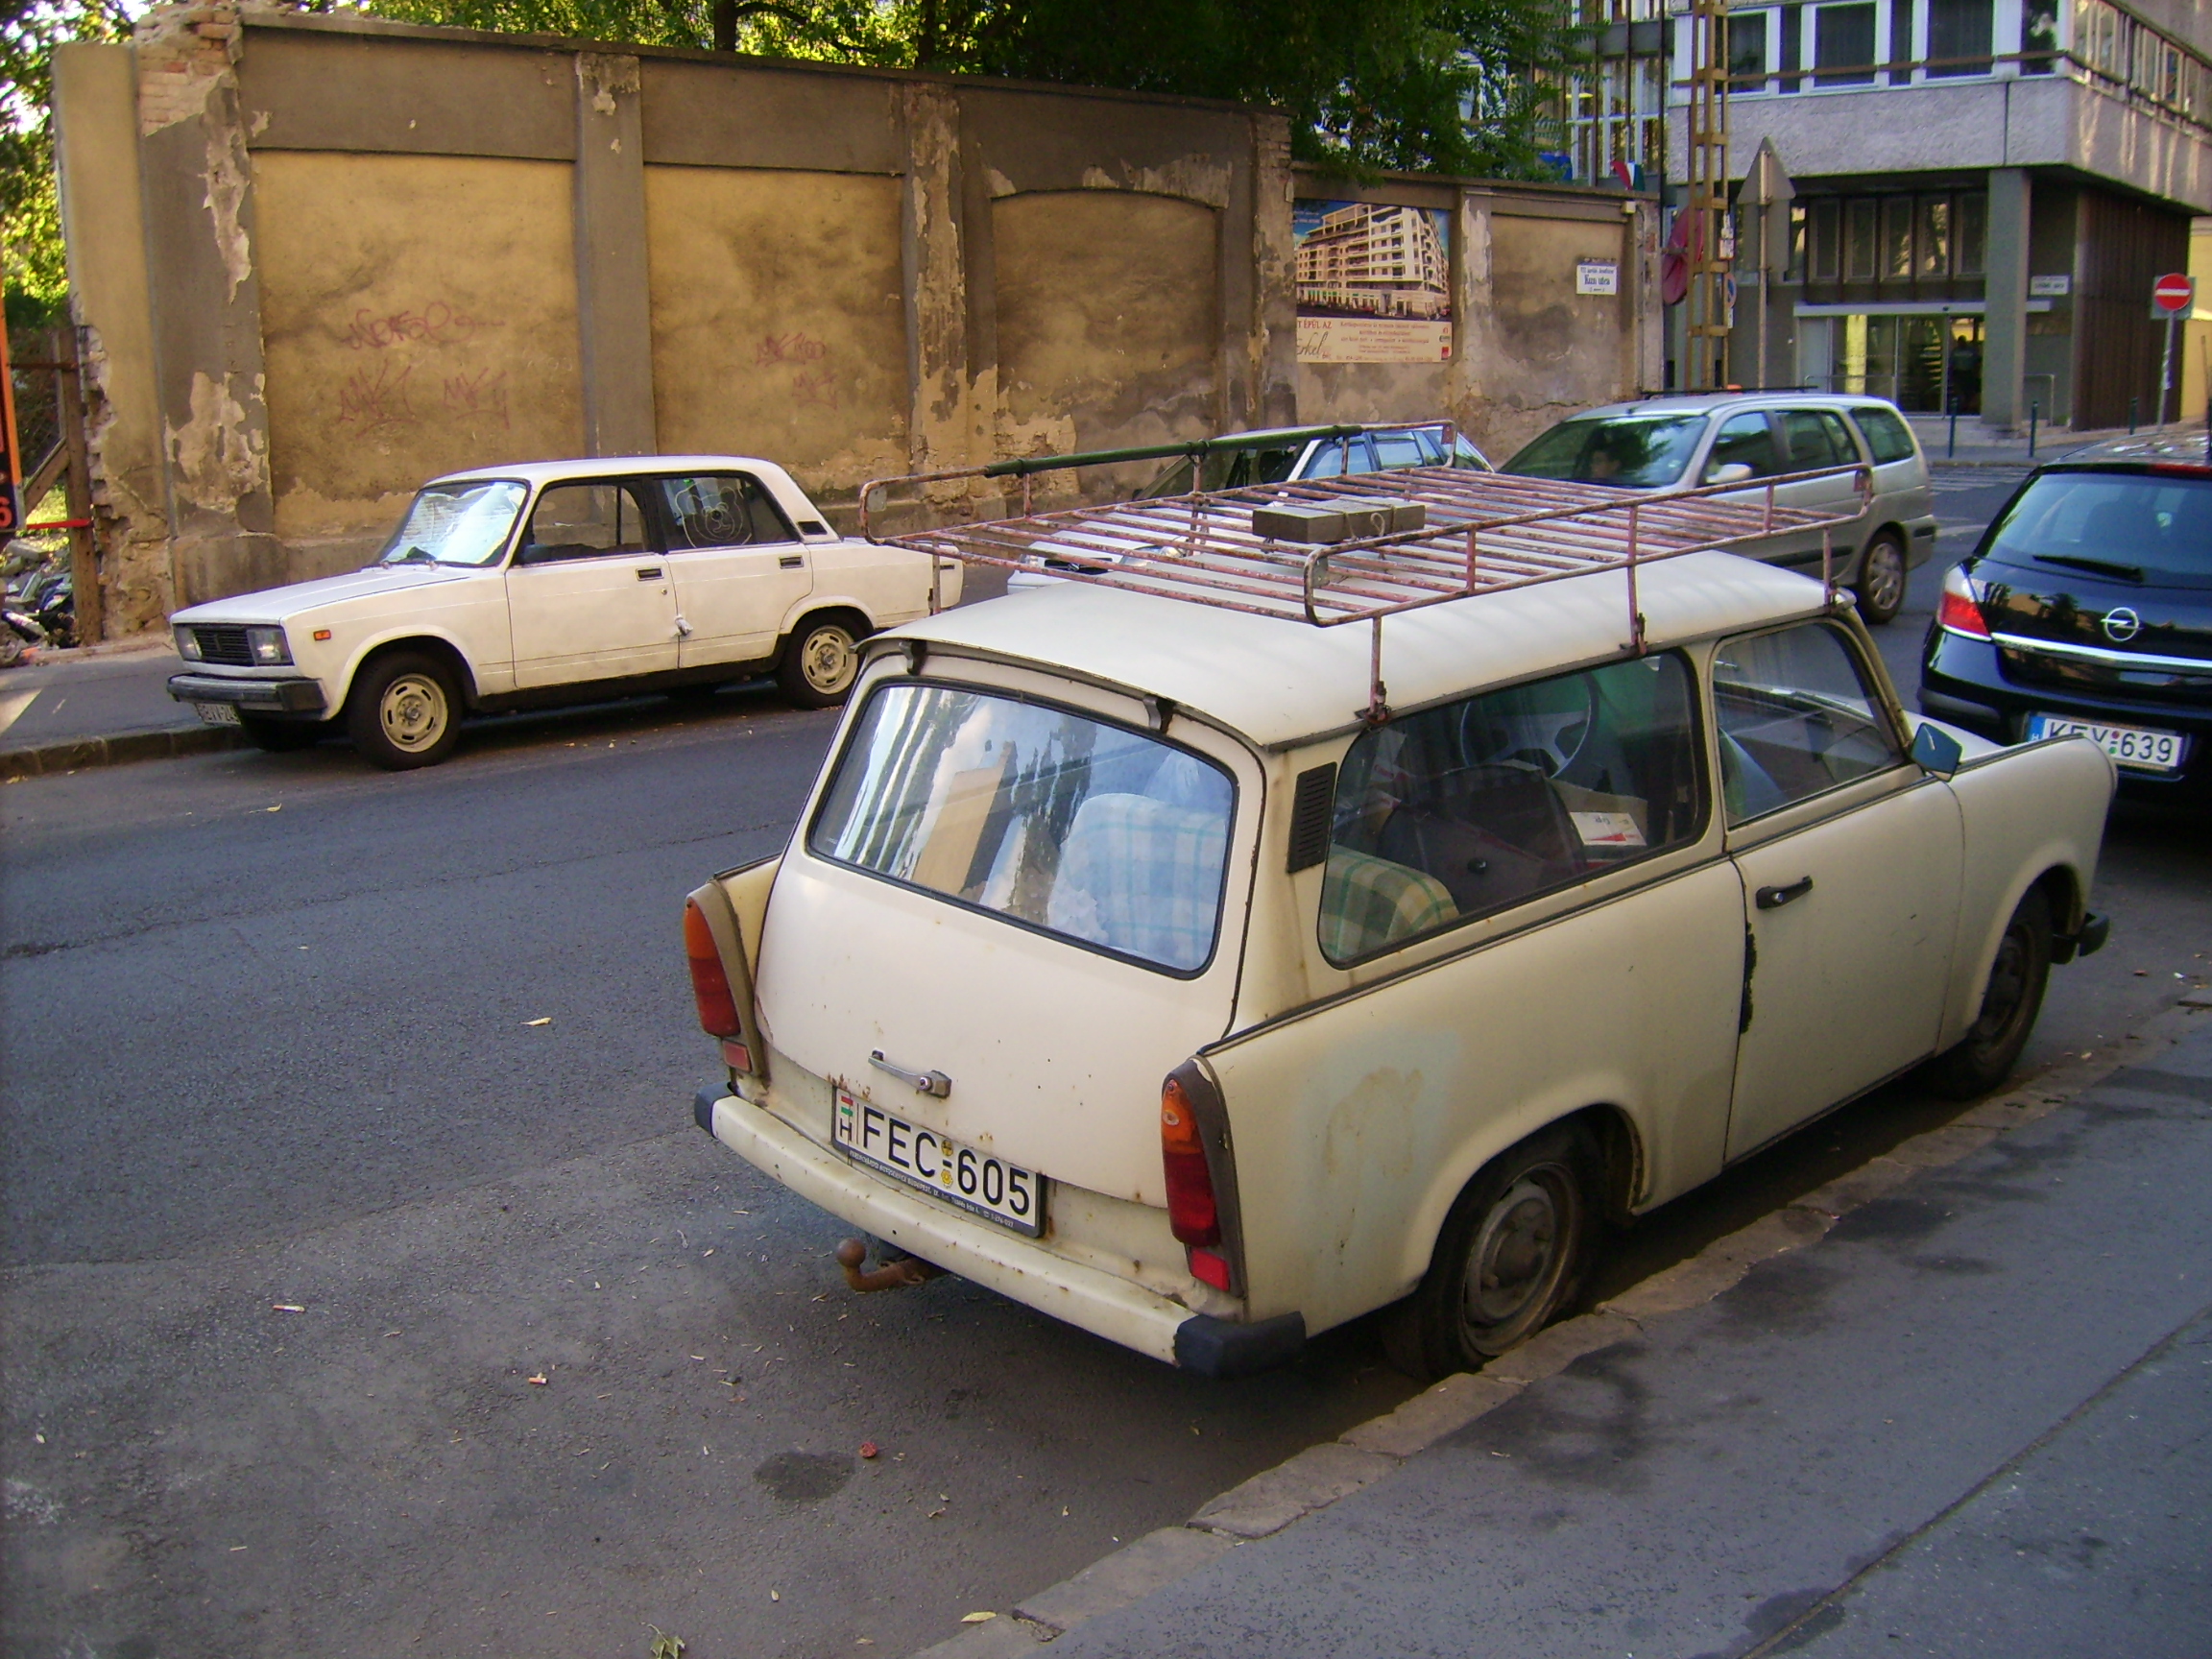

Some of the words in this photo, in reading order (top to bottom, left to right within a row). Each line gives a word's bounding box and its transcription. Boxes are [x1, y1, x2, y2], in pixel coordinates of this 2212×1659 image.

[1599, 276, 1611, 286] utca
[840, 1117, 853, 1142] H
[863, 1105, 1030, 1216] FEC-605
